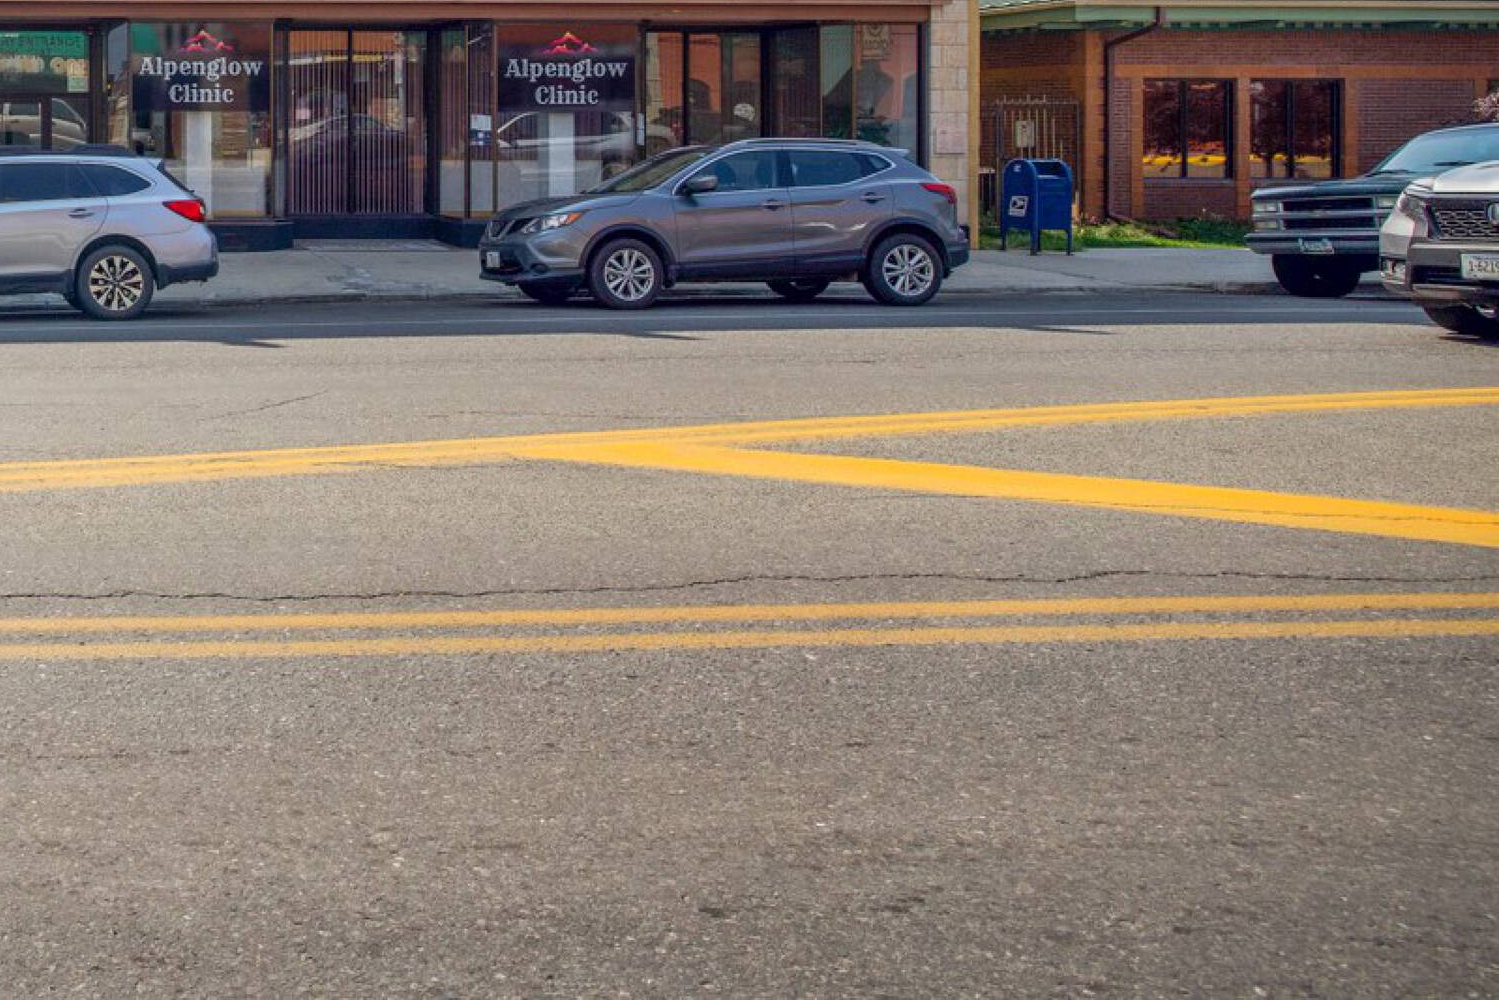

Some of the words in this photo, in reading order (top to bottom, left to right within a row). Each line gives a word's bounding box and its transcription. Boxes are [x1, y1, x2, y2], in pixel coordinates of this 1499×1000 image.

[139, 56, 263, 82] Alpenglow
[504, 58, 629, 83] Alpenglow
[169, 83, 235, 103] Clinic
[535, 84, 599, 105] Clinic
